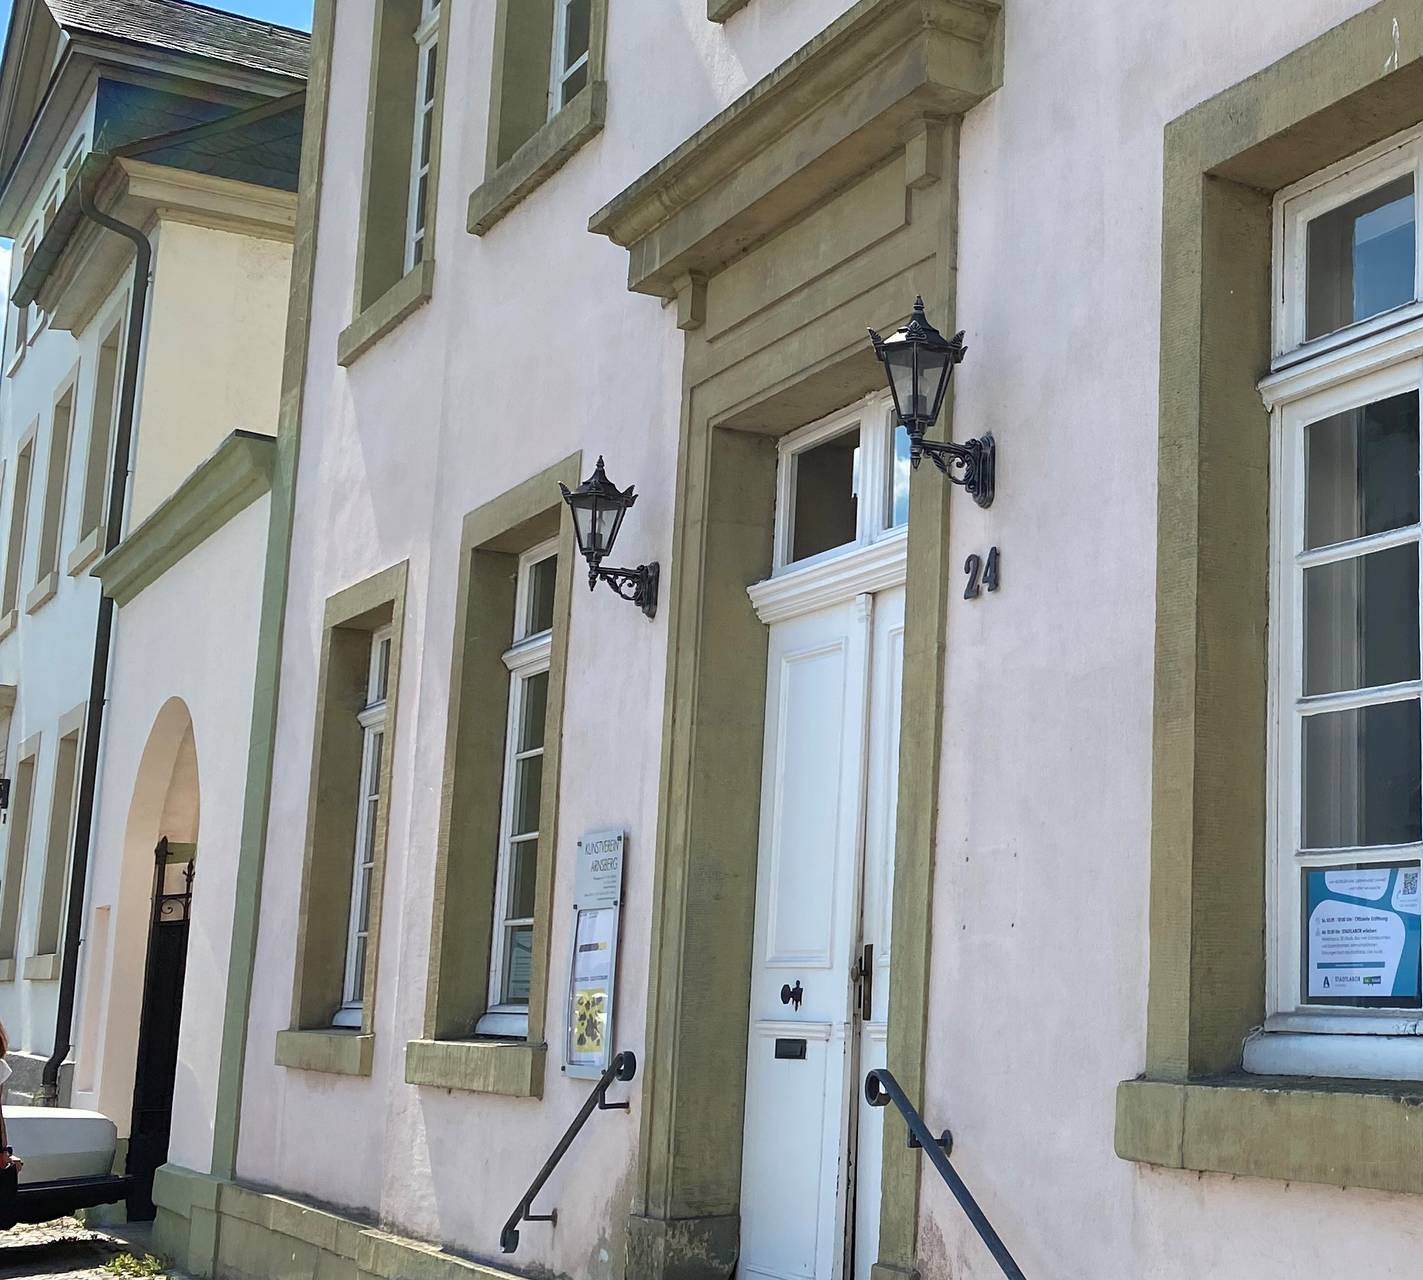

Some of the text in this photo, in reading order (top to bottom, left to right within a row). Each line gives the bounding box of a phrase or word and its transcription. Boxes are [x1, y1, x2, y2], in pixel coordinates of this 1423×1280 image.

[964, 546, 1000, 600] 24
[585, 839, 619, 855] KUNSTVEREIN
[591, 857, 618, 872] ARNSBERG
